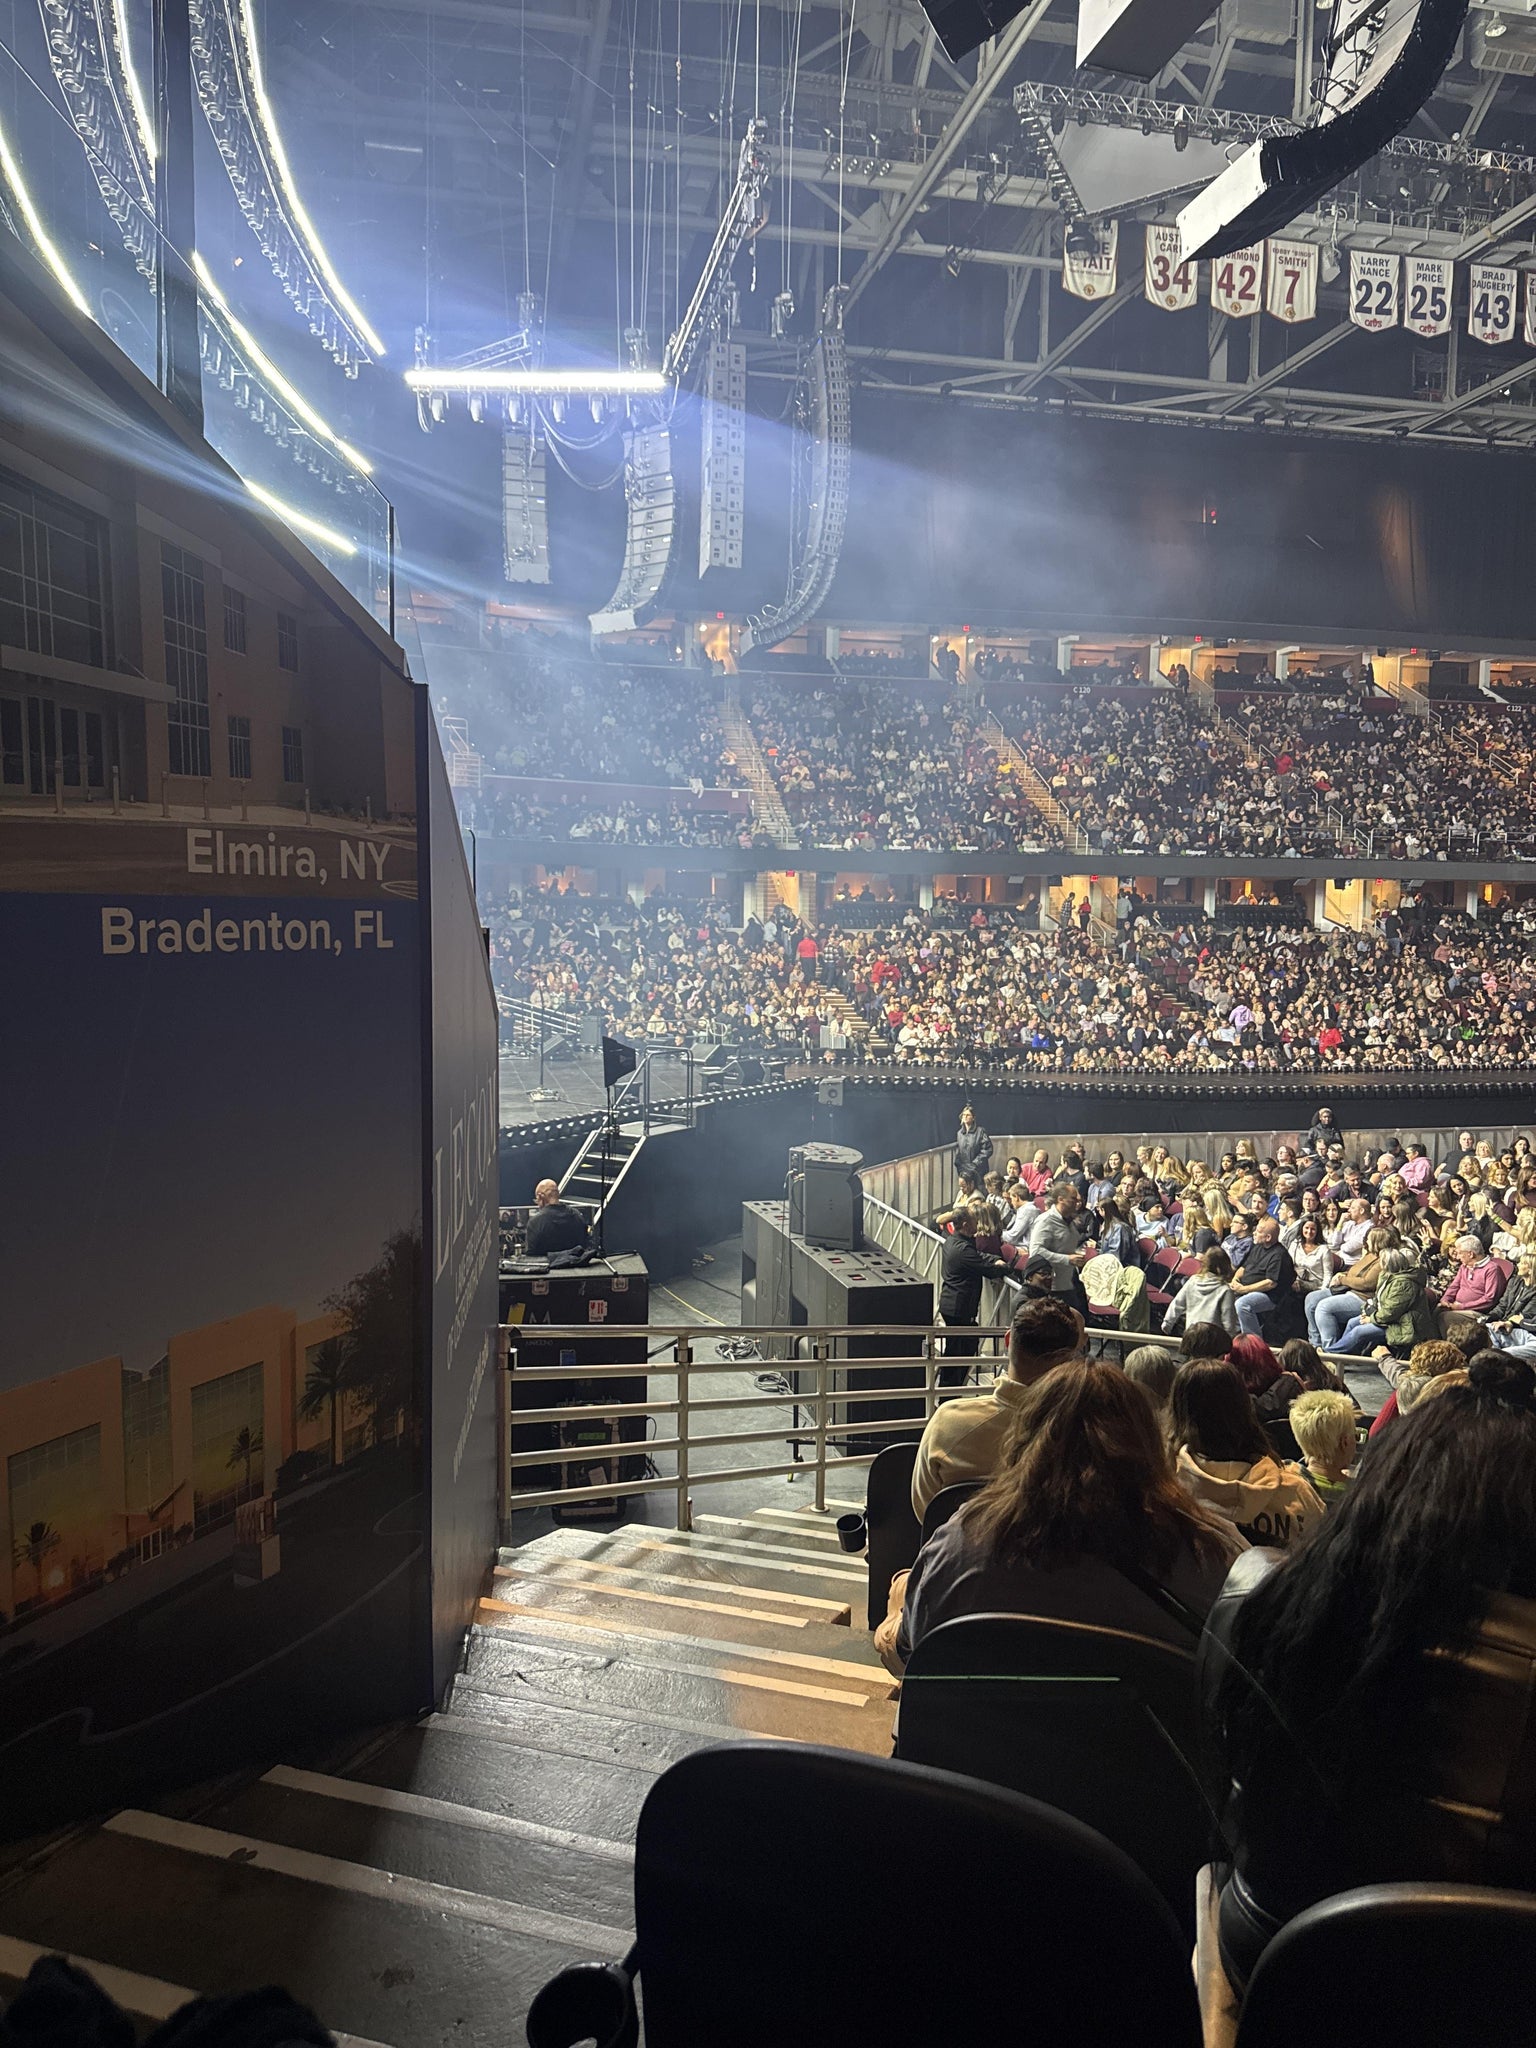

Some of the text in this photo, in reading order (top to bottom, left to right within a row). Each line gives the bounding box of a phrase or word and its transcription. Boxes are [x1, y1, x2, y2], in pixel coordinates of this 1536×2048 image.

[1152, 255, 1192, 294] 34
[1278, 256, 1308, 267] SMITH
[1360, 256, 1390, 267] LARRY
[1360, 267, 1390, 278] NANCE
[1416, 262, 1443, 273] MARK
[1416, 273, 1443, 283] PRICE
[1482, 271, 1506, 281] BRAD
[1217, 262, 1256, 301] 42
[1284, 269, 1300, 304] 7
[1355, 279, 1393, 316] 22
[1472, 280, 1515, 292] DAUGHERTY
[1410, 285, 1447, 322] 25
[1474, 293, 1510, 330] 43
[1079, 686, 1091, 694] 120
[186, 828, 391, 885] Elmira, NY
[101, 906, 394, 957] Bradenton, FL
[435, 1069, 497, 1284] LECOM
